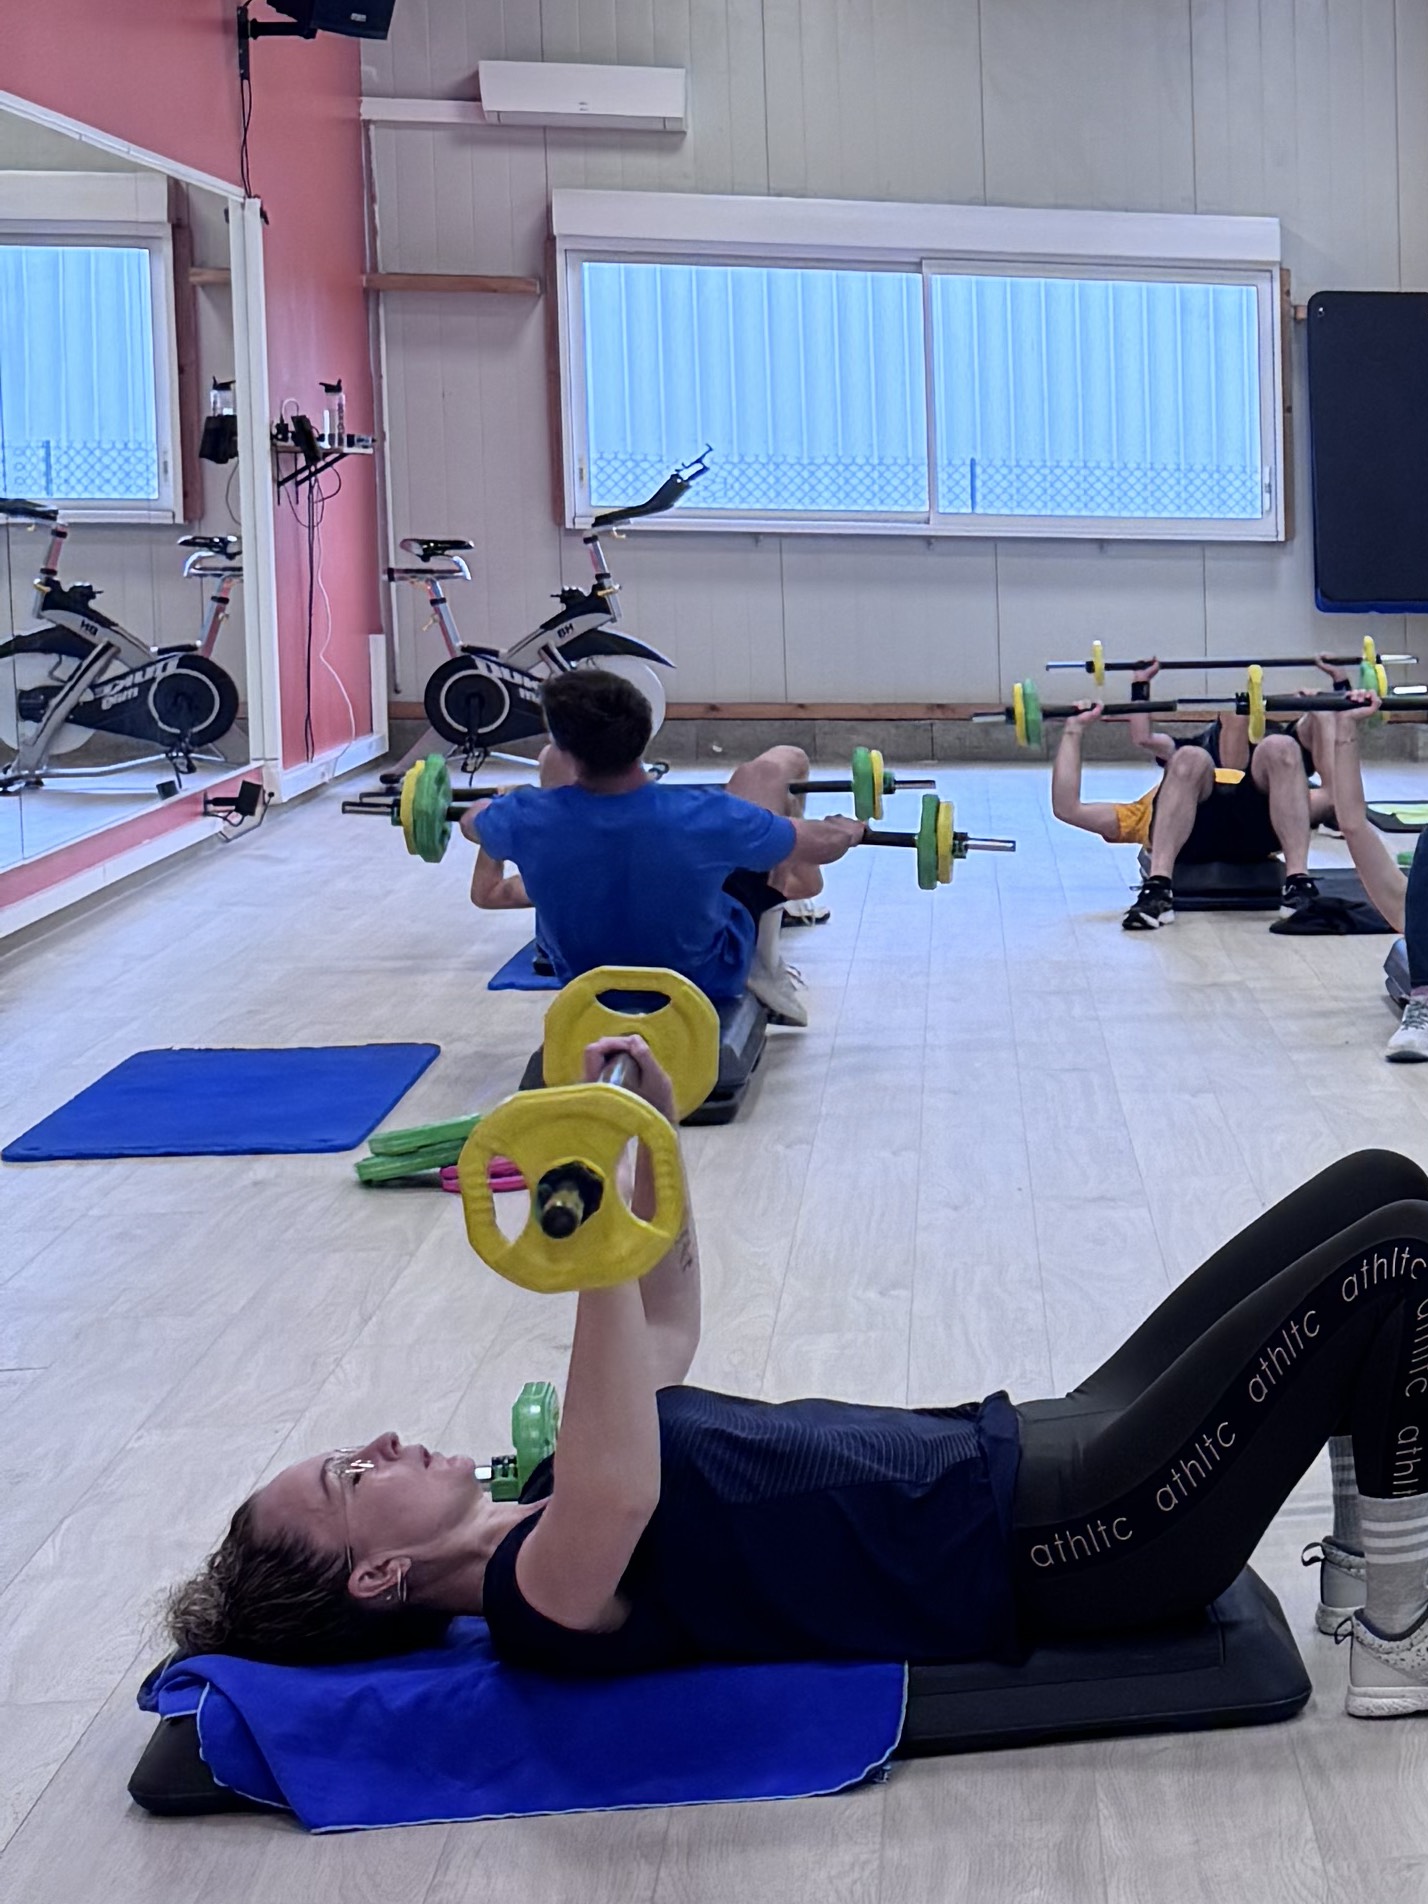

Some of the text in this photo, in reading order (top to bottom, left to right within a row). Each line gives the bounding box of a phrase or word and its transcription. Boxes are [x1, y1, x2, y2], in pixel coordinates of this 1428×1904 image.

[1342, 1245, 1428, 1302] athltc
[1248, 1309, 1321, 1403] athltc
[1156, 1421, 1237, 1512] athltc
[1392, 1425, 1423, 1495] athlt
[1030, 1516, 1134, 1567] athltc
